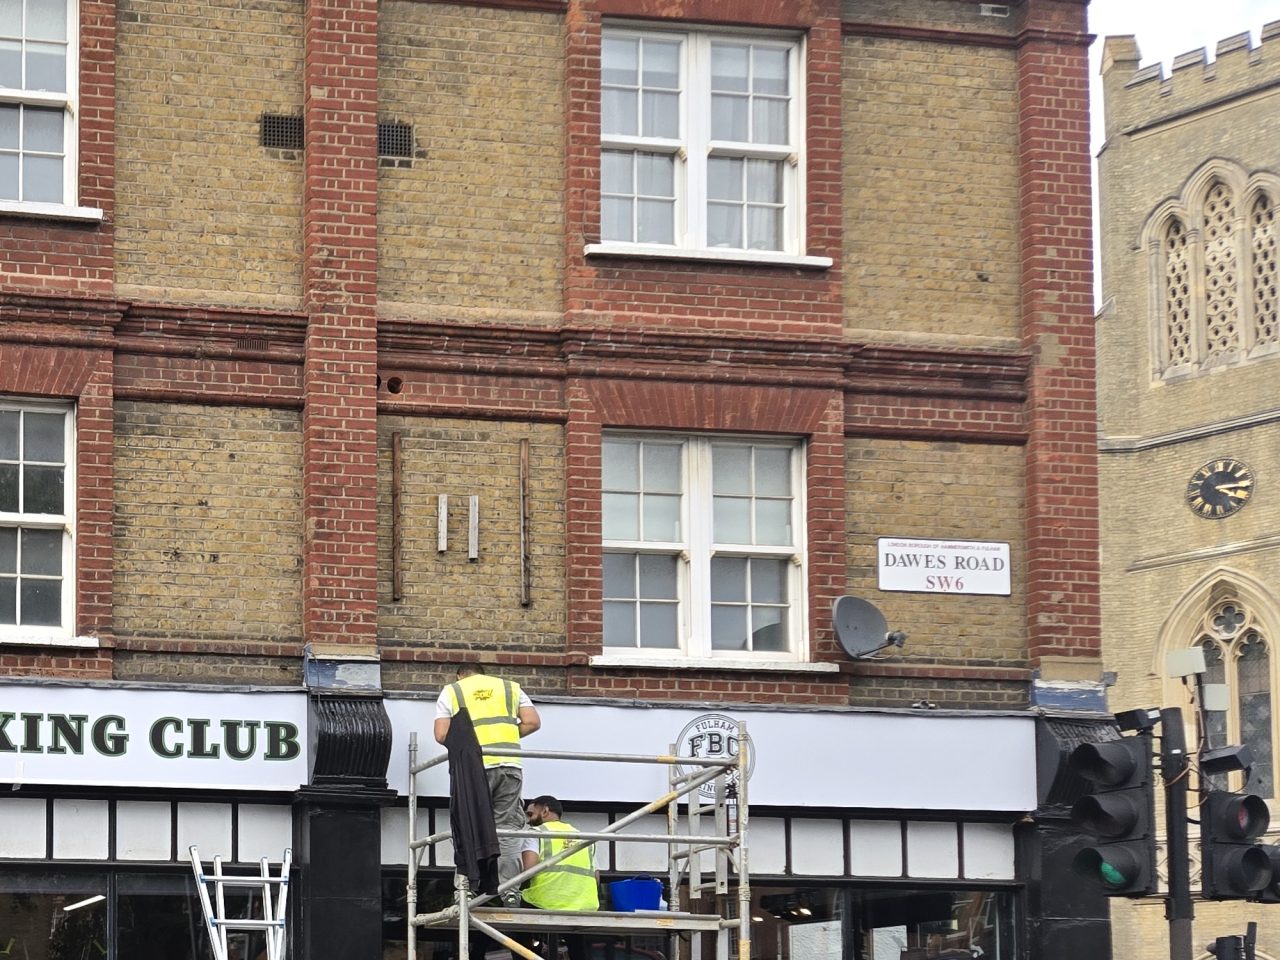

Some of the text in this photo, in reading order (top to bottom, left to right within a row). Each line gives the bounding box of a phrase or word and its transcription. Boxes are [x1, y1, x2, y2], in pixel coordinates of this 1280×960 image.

[884, 552, 1004, 572] DAWES ROAD
[926, 575, 964, 590] SW6
[695, 720, 735, 733] FULHAM
[149, 716, 301, 761] CLUB
